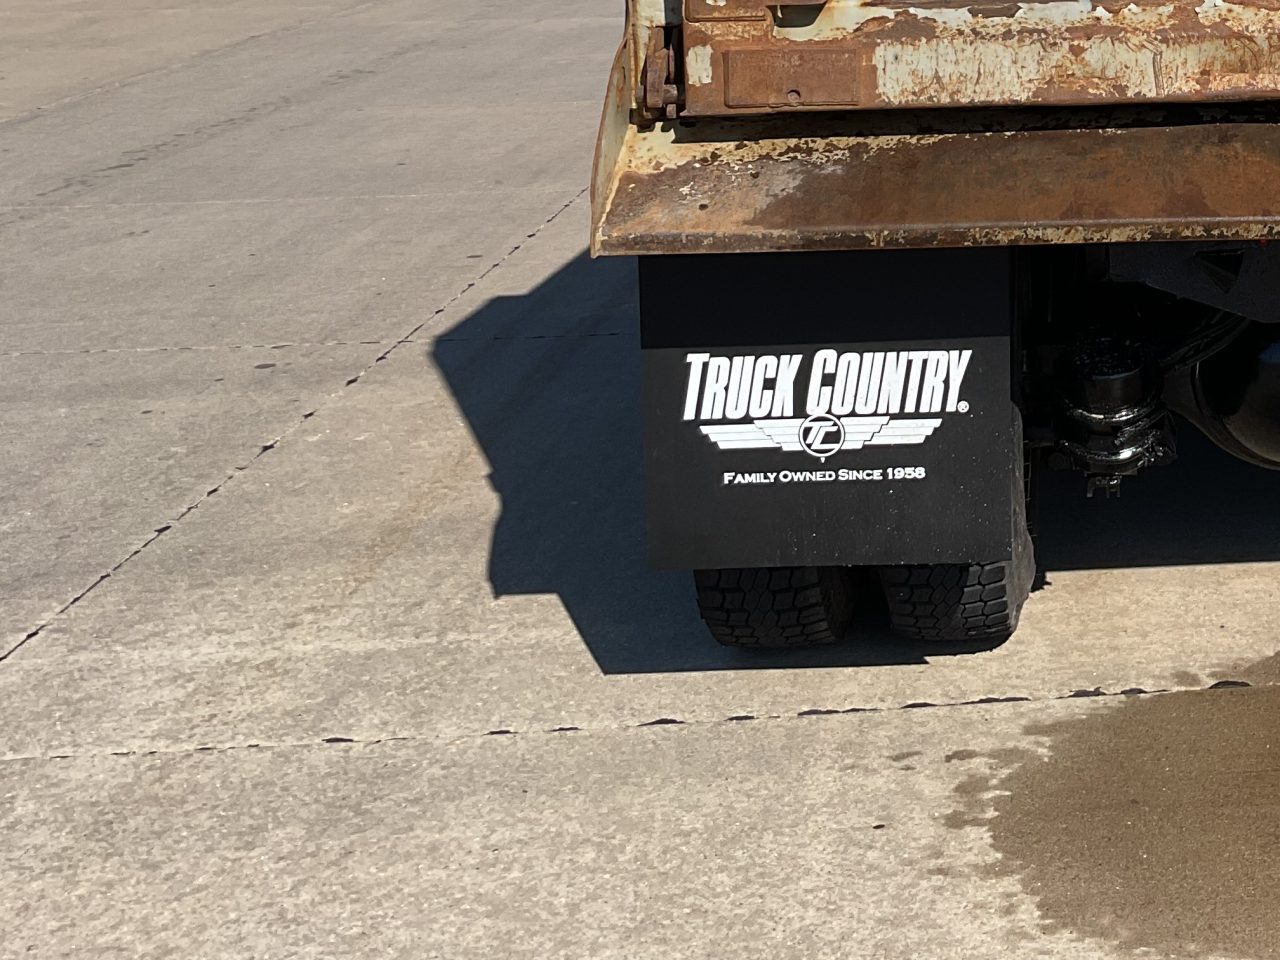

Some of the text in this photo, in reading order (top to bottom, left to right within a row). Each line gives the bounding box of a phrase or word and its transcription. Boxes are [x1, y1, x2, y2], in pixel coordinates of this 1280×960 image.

[683, 353, 803, 421] TRUCK
[723, 467, 926, 484] FAMILY OWNED SINCE 1958
